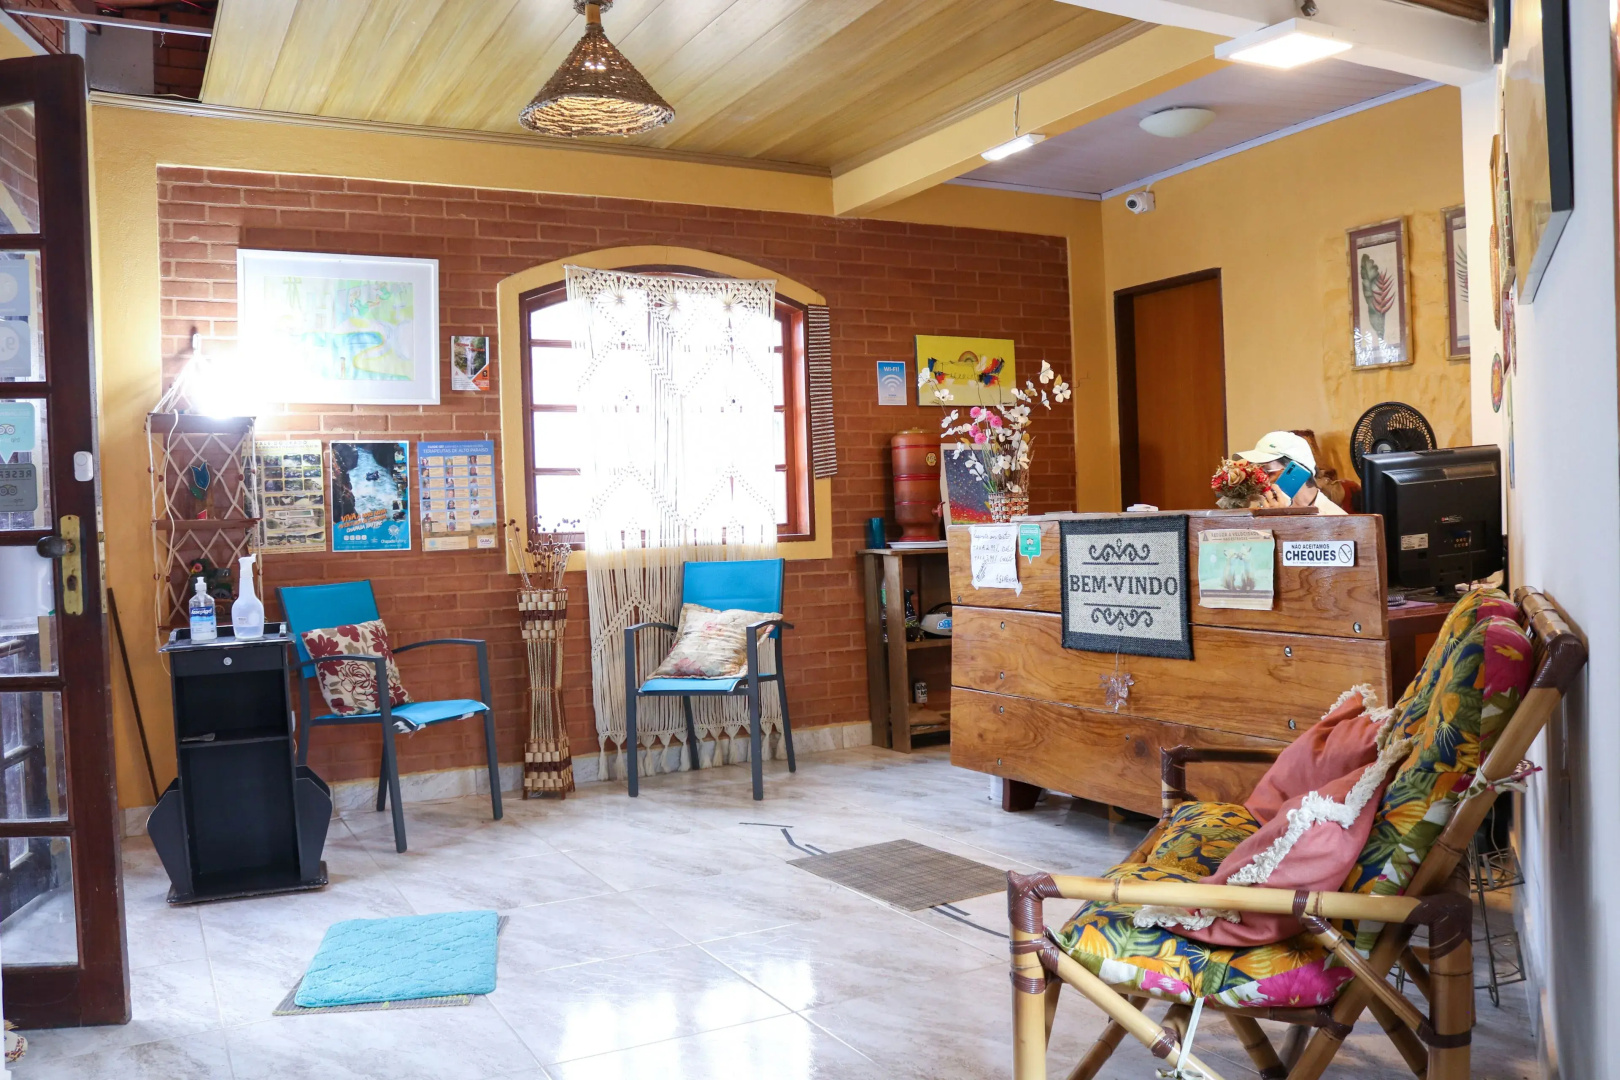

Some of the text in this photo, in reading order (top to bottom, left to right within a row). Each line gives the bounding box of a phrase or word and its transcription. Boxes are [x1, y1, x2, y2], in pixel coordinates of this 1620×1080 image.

[341, 513, 356, 522] VIVA
[1285, 550, 1337, 561] CHEQUES
[1069, 574, 1179, 596] BEM-VINDO
